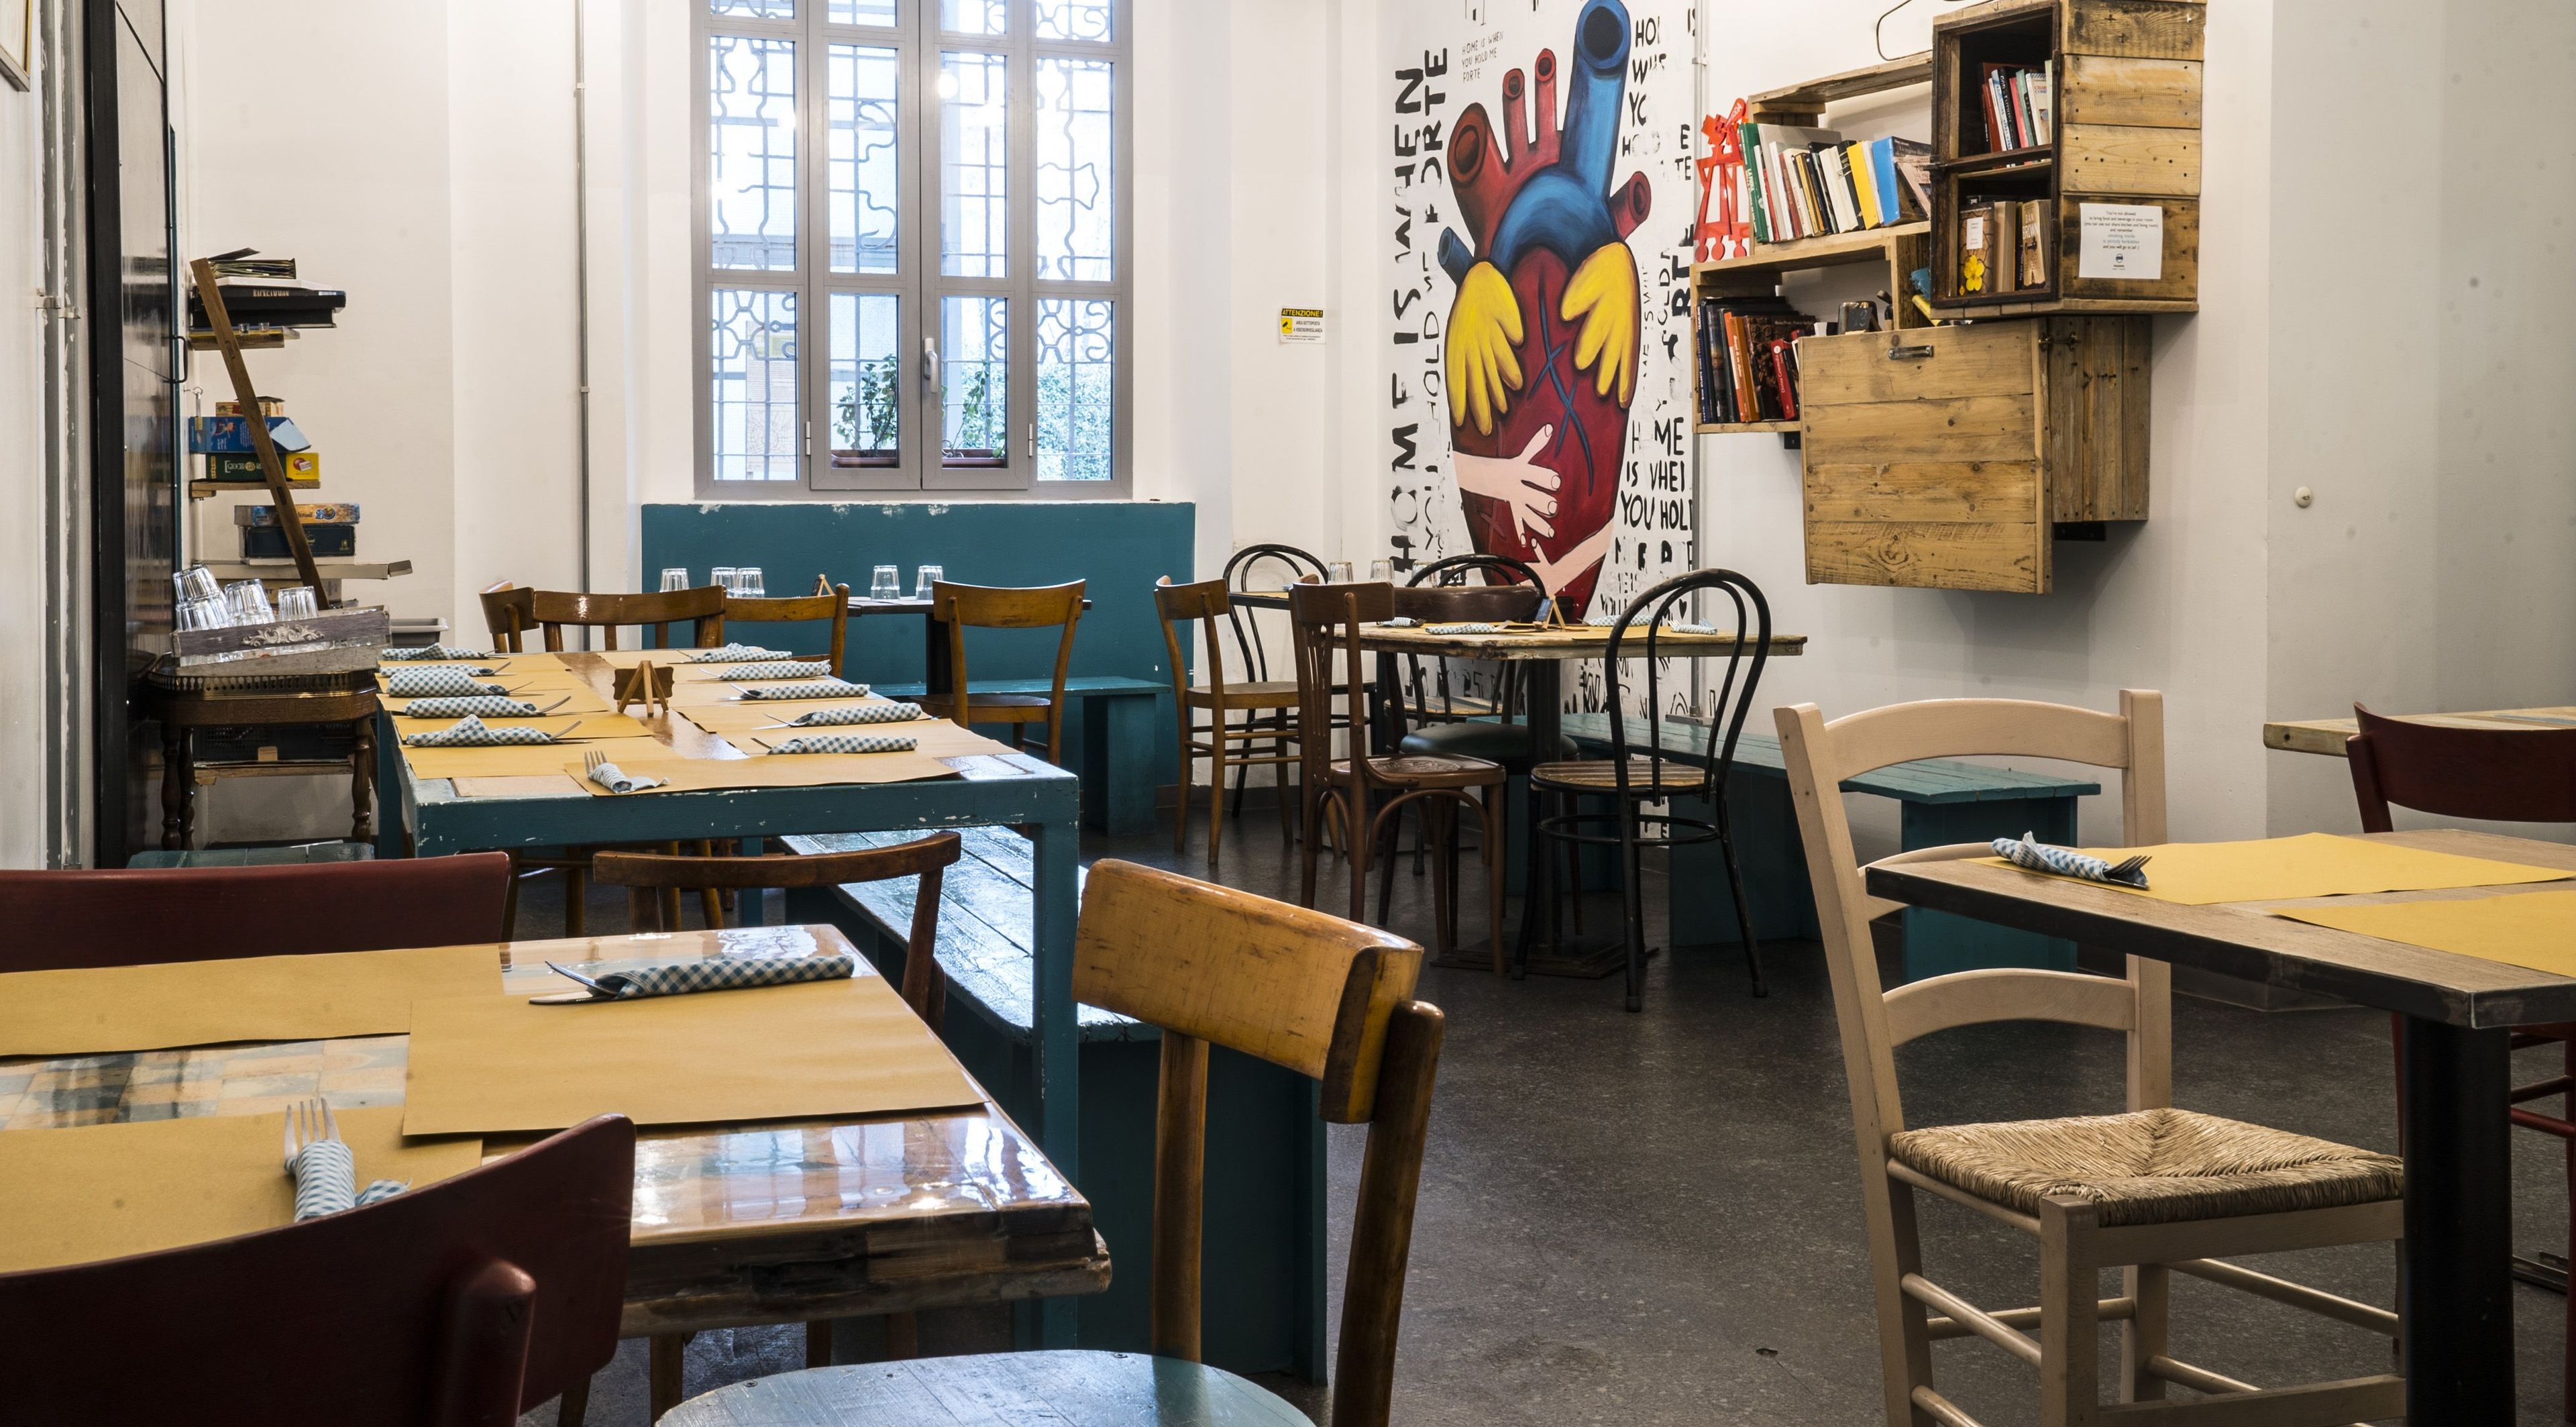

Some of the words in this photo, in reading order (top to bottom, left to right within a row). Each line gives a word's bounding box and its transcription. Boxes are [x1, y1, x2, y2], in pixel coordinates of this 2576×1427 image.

[1462, 40, 1478, 55] HOME
[1481, 38, 1485, 48] IS
[1488, 31, 1503, 44] WHEN
[1462, 58, 1472, 69] YOU
[1474, 51, 1488, 64] HOLD
[1489, 47, 1497, 59] ME
[1463, 68, 1480, 83] FORTE
[1282, 309, 1323, 317] ATTENZIONE!
[1393, 288, 1421, 344] IS
[1626, 460, 1639, 487] IS
[1621, 490, 1655, 531] YOU
